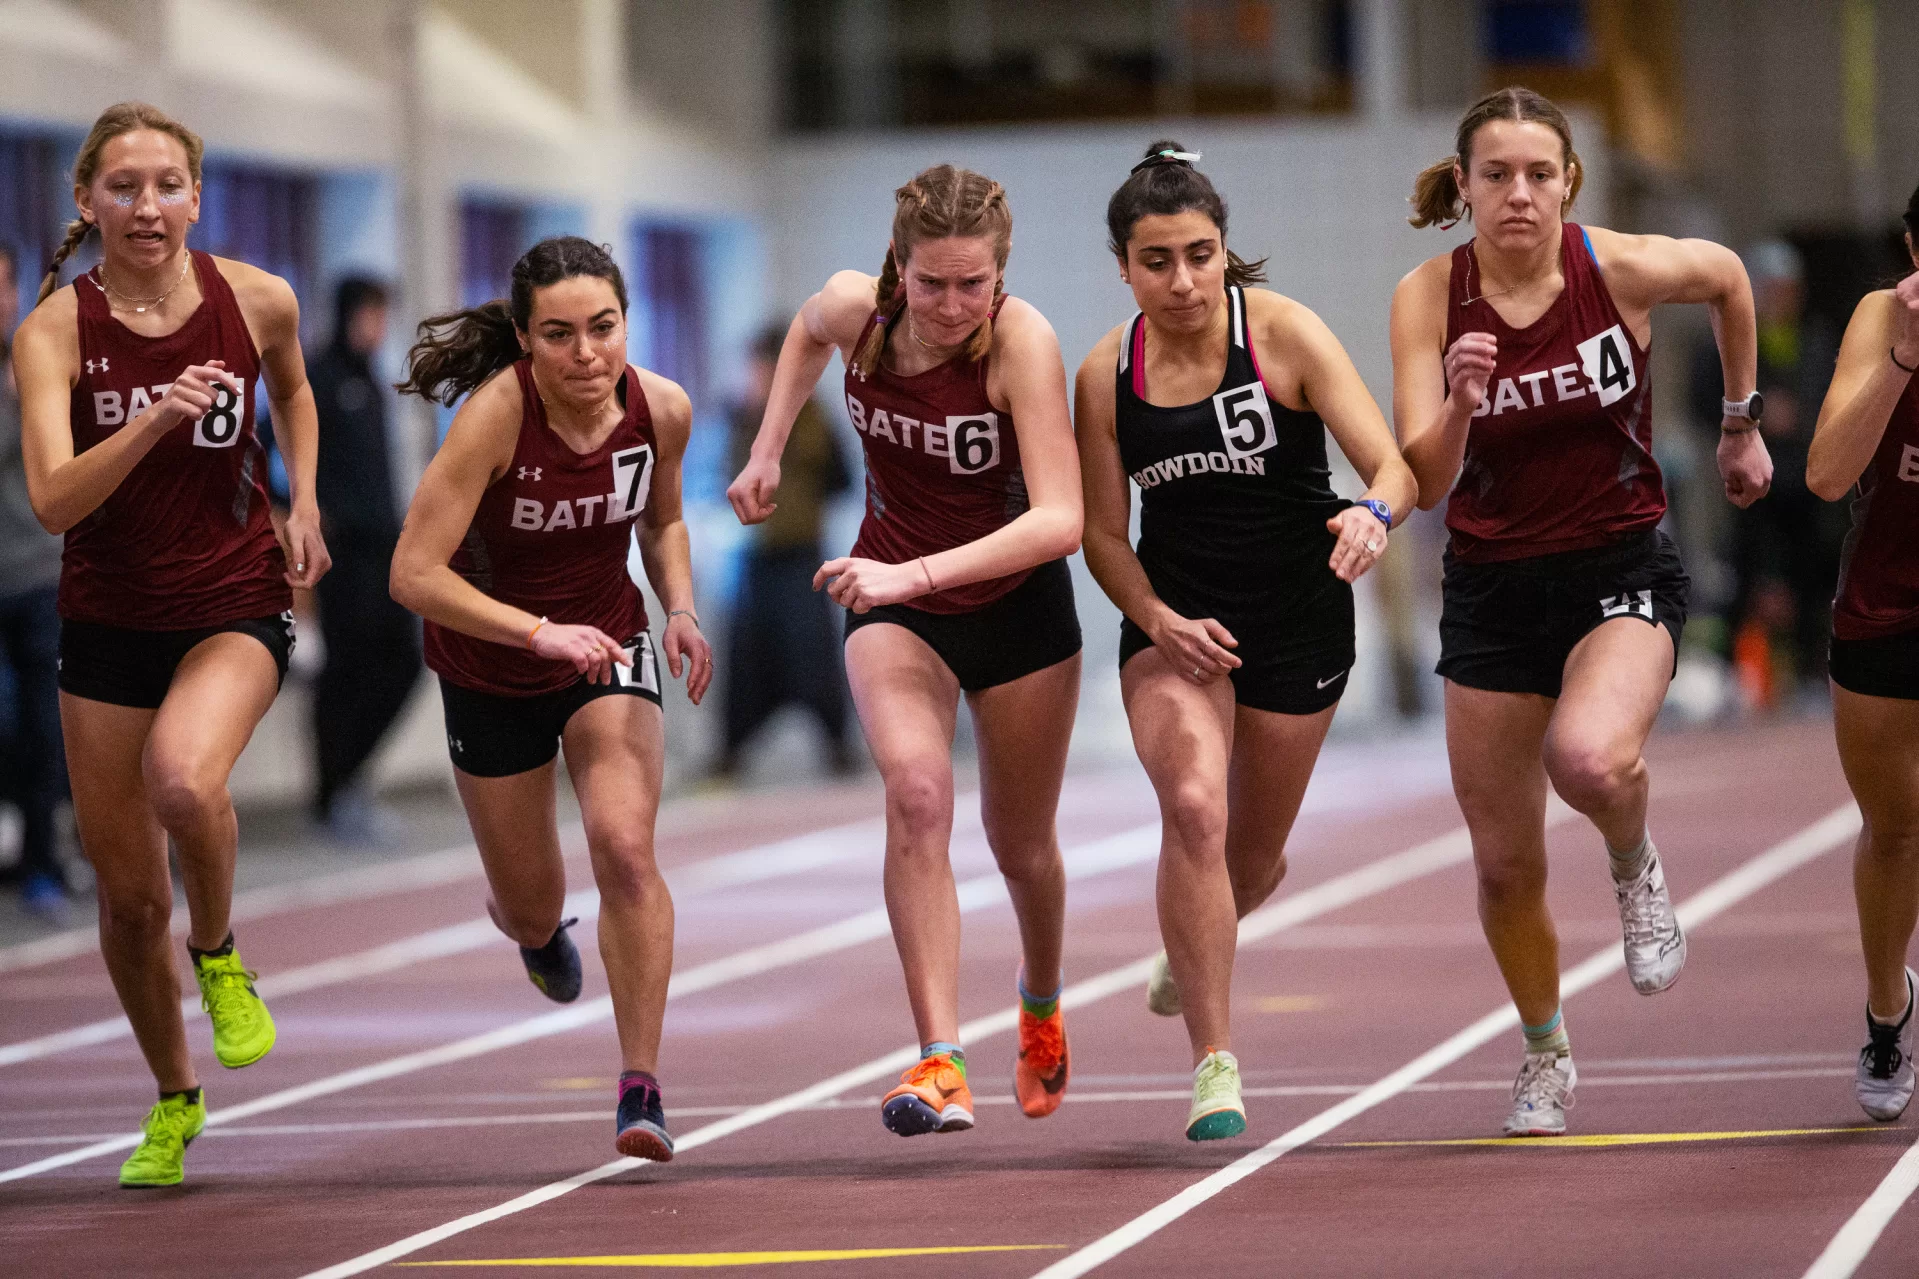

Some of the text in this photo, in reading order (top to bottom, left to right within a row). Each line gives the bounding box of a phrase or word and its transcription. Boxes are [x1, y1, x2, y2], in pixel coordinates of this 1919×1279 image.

[1600, 334, 1630, 392] 4
[202, 382, 237, 443] 8
[847, 392, 950, 458] BATE
[1222, 388, 1267, 451] 5
[954, 420, 993, 471] 6
[1132, 451, 1266, 490] BOWDOIN
[617, 450, 648, 512] 7
